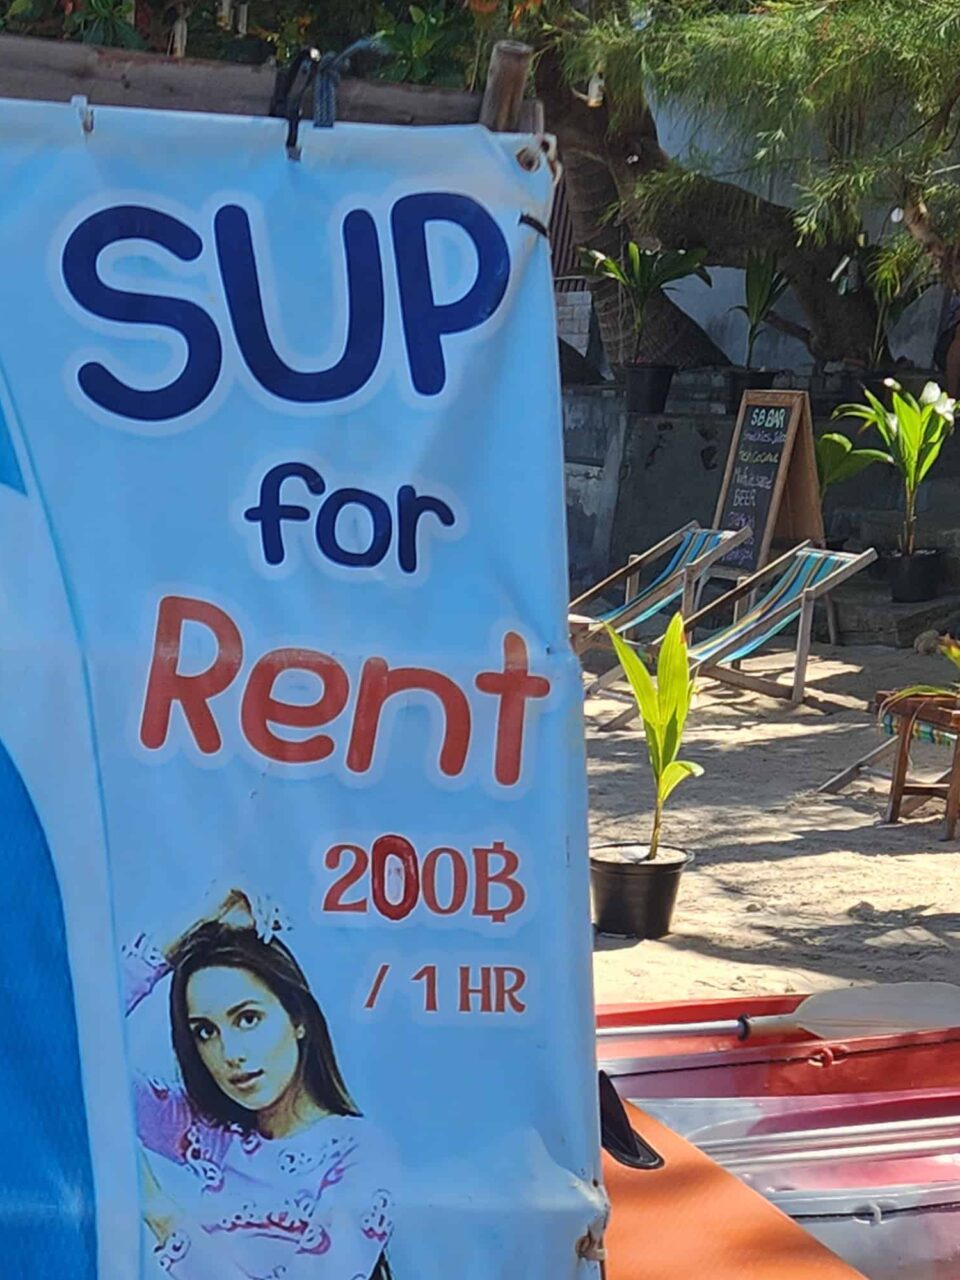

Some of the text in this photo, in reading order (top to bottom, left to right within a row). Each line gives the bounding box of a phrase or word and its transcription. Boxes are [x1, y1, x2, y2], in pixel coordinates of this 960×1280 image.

[62, 192, 510, 421] SUP
[244, 462, 455, 574] for
[140, 595, 551, 786] Rent
[458, 965, 526, 1014] HR
